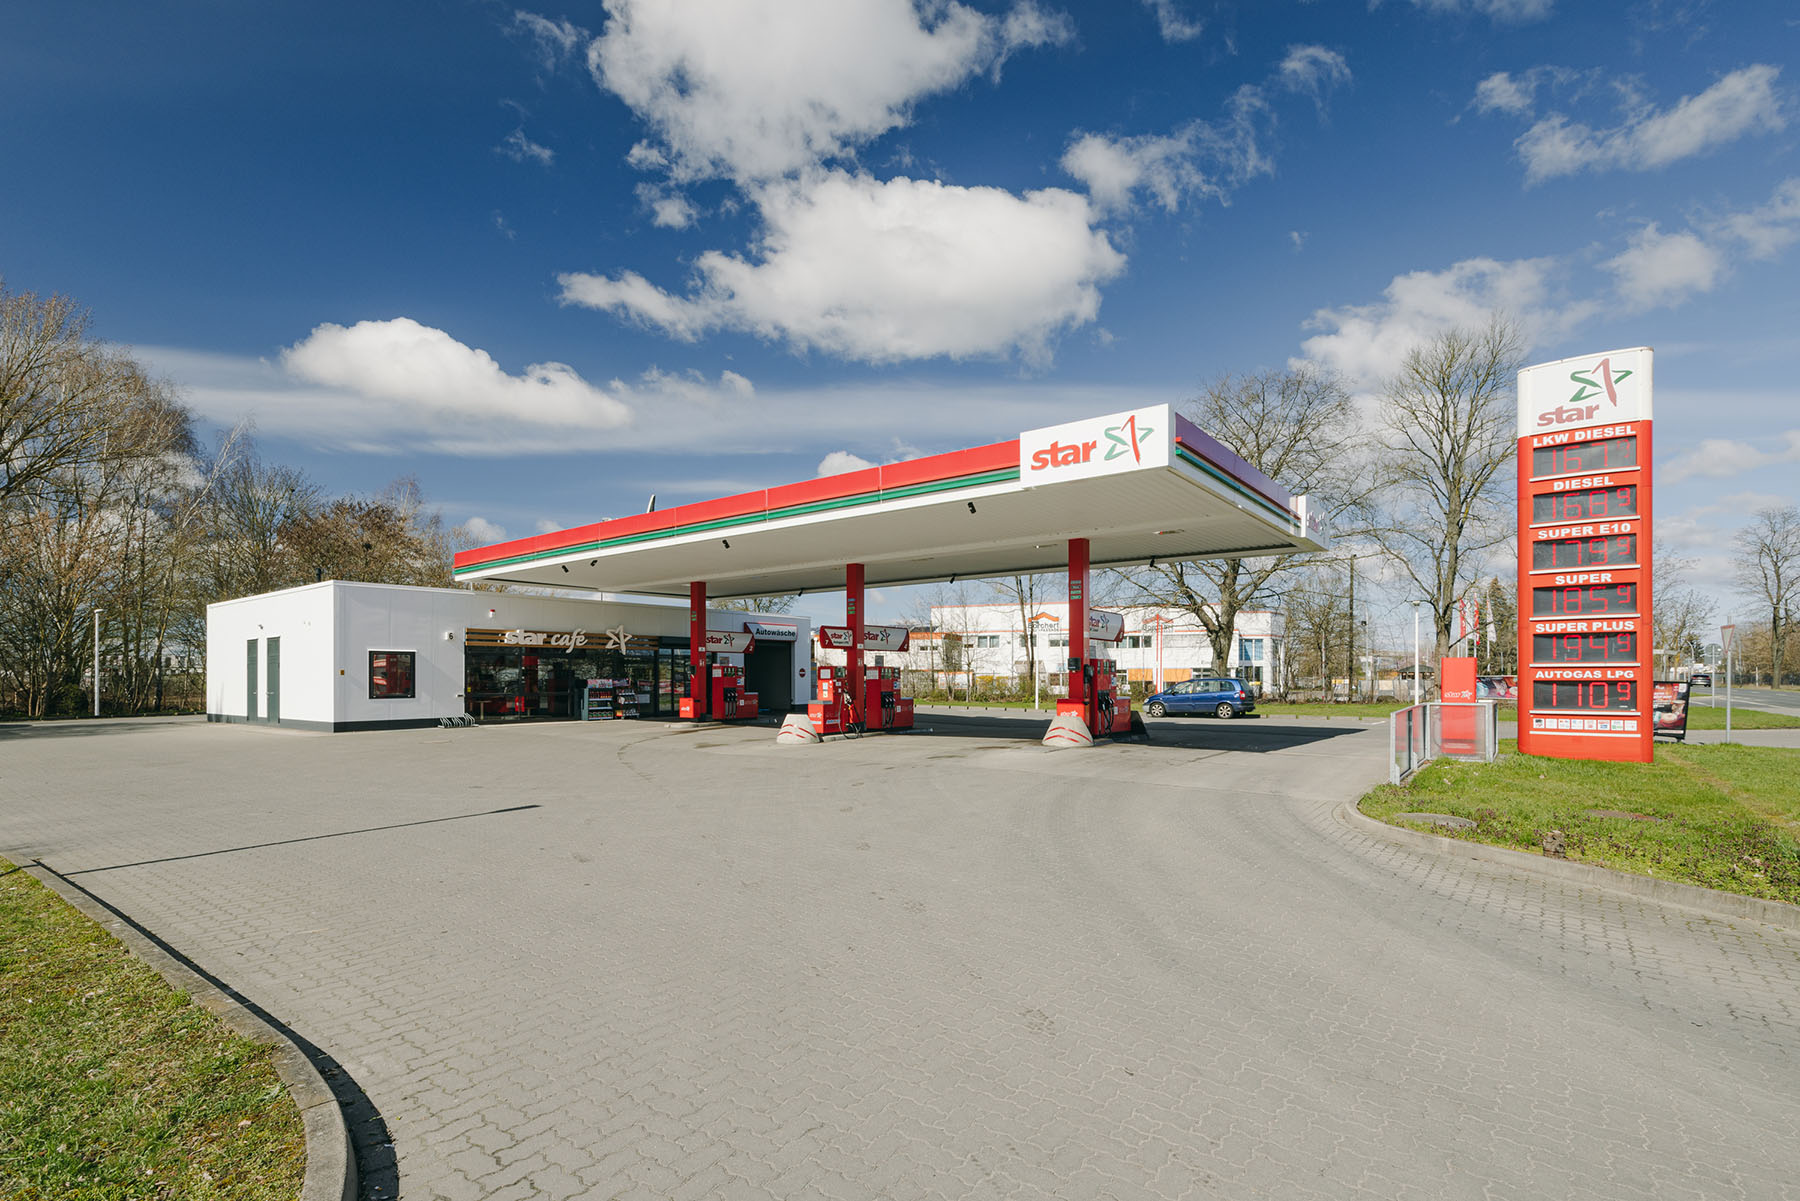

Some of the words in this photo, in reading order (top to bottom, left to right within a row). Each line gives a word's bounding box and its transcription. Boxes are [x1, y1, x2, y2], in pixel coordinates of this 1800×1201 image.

[1537, 404, 1599, 427] star
[1533, 432, 1569, 447] LKW
[1575, 425, 1637, 442] DIESEL
[1031, 440, 1097, 471] star
[1553, 476, 1614, 491] DIESEL
[1538, 525, 1593, 539] SUPER
[1599, 523, 1631, 535] E10
[1555, 573, 1612, 585] SUPER
[755, 627, 797, 638] Autowäsche
[1535, 622, 1588, 633] SUPER
[1592, 620, 1635, 632] PLUS
[504, 629, 547, 646] star
[550, 628, 588, 654] café
[705, 633, 723, 644] star
[864, 631, 880, 641] star
[1535, 670, 1602, 679] AUTOGAS
[1606, 670, 1635, 679] LPG
